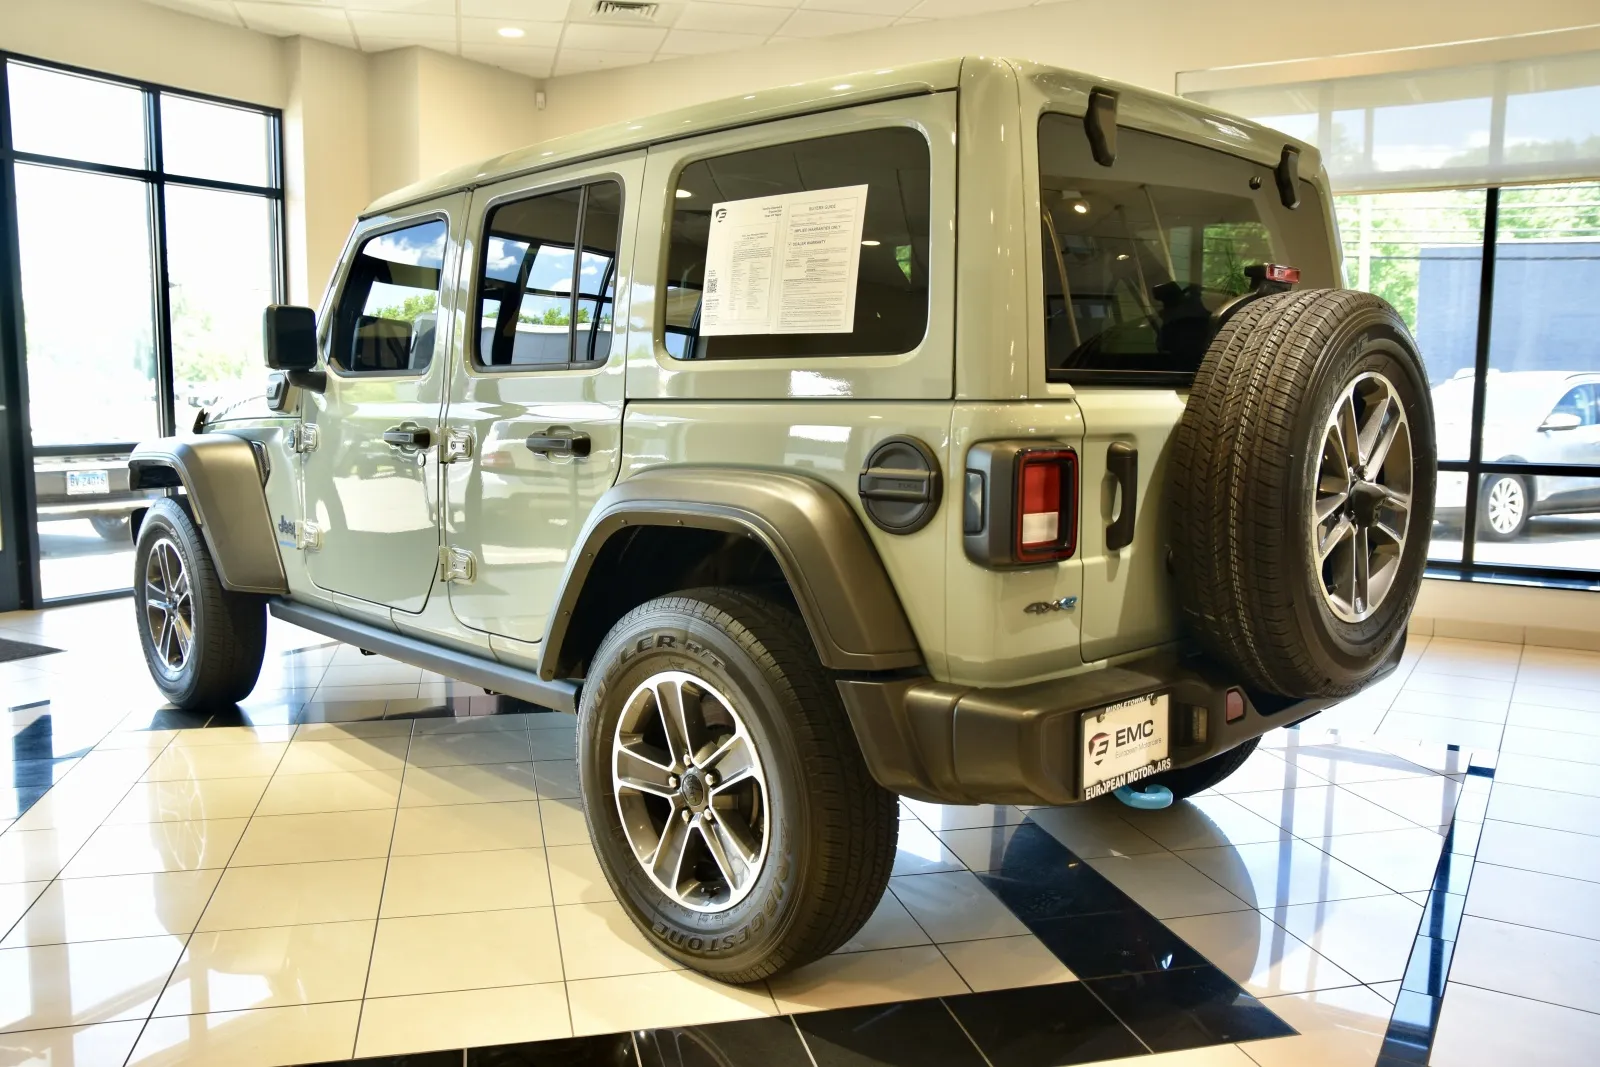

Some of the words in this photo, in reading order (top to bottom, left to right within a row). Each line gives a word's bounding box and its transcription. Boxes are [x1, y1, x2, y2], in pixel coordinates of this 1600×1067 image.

[1115, 719, 1154, 748] EMC
[1115, 747, 1138, 759] European
[1139, 738, 1162, 750] Motorcars
[1085, 773, 1126, 800] EUROPEAN
[1127, 758, 1171, 783] MOTORCARS
